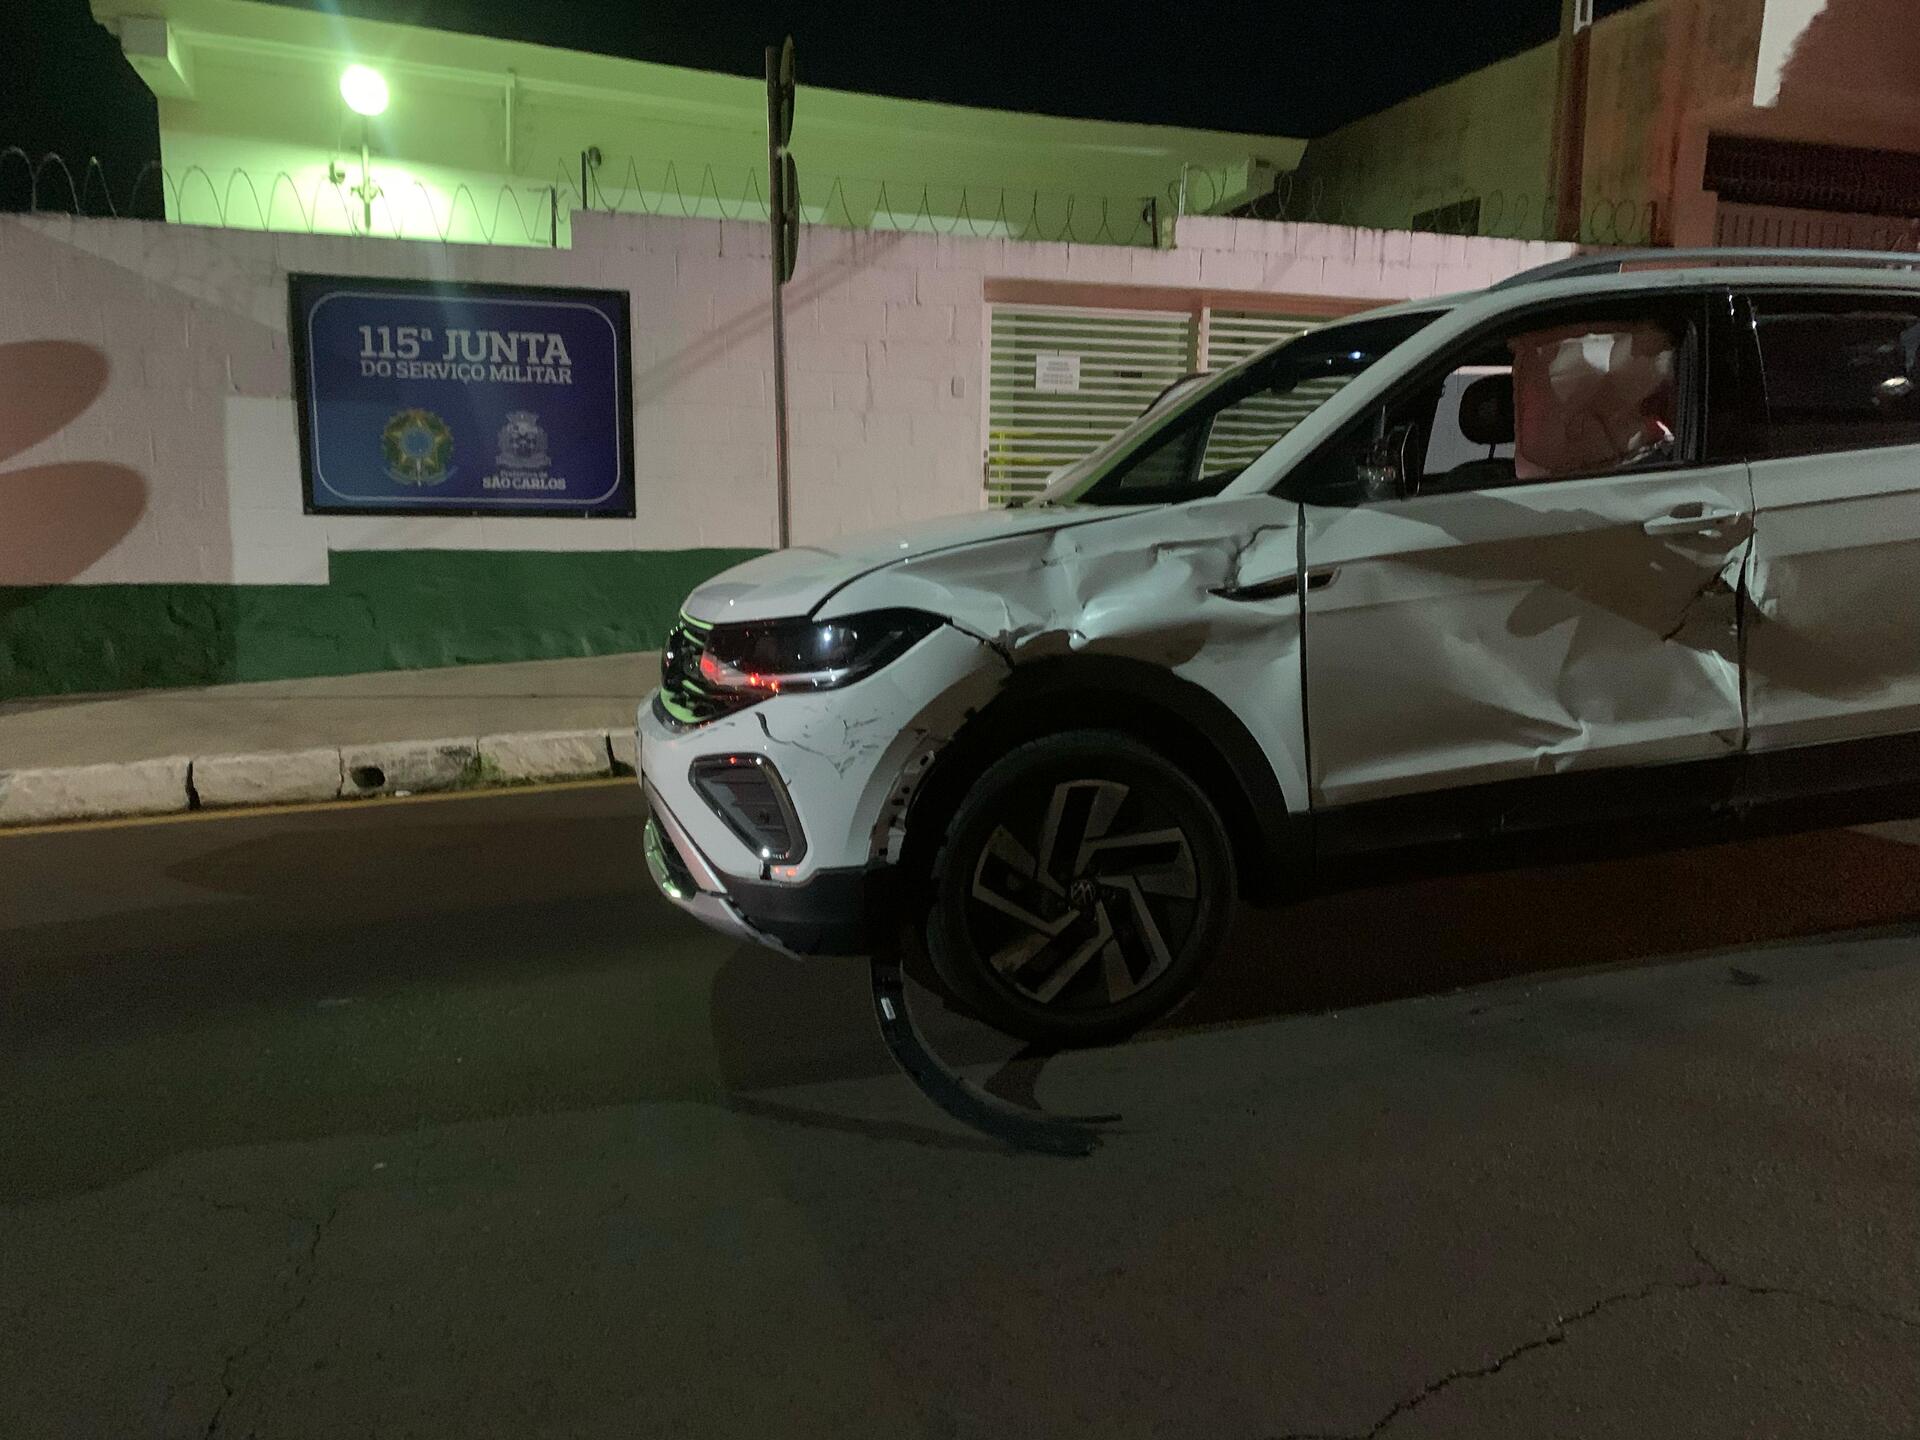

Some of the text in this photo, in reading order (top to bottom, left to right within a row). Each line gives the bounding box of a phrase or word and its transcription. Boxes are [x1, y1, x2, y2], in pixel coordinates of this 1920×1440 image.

[359, 325, 573, 366] 115ª JUNTA
[360, 360, 573, 384] DO SERVIÇO MILITAR
[512, 477, 566, 490] CARLOS
